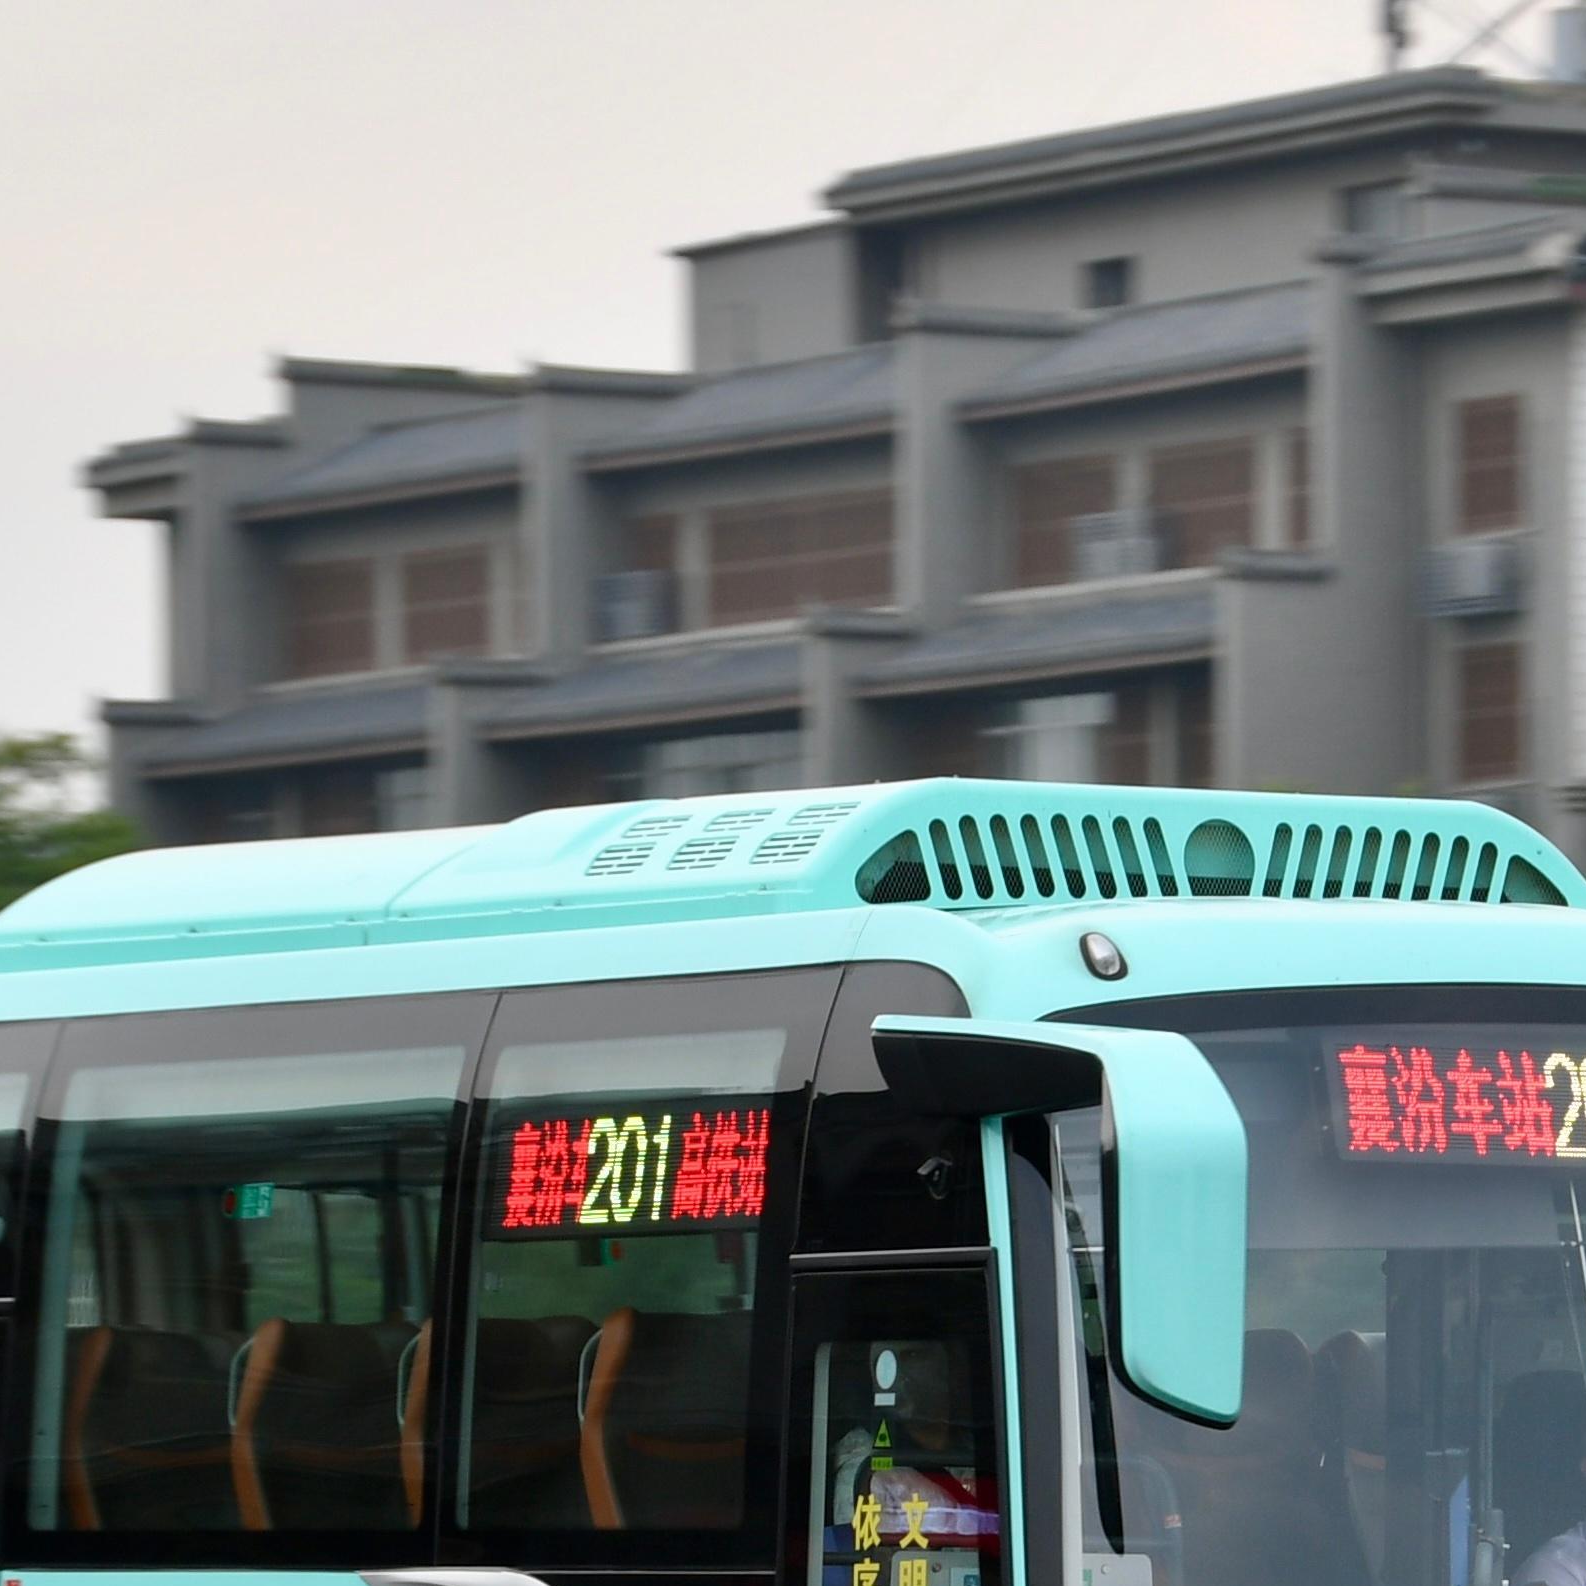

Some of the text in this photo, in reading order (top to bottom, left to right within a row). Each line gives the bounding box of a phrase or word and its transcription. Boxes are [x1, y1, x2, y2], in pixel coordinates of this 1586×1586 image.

[1337, 1044, 1556, 1158] 襄汾车站
[579, 1114, 672, 1224] 201
